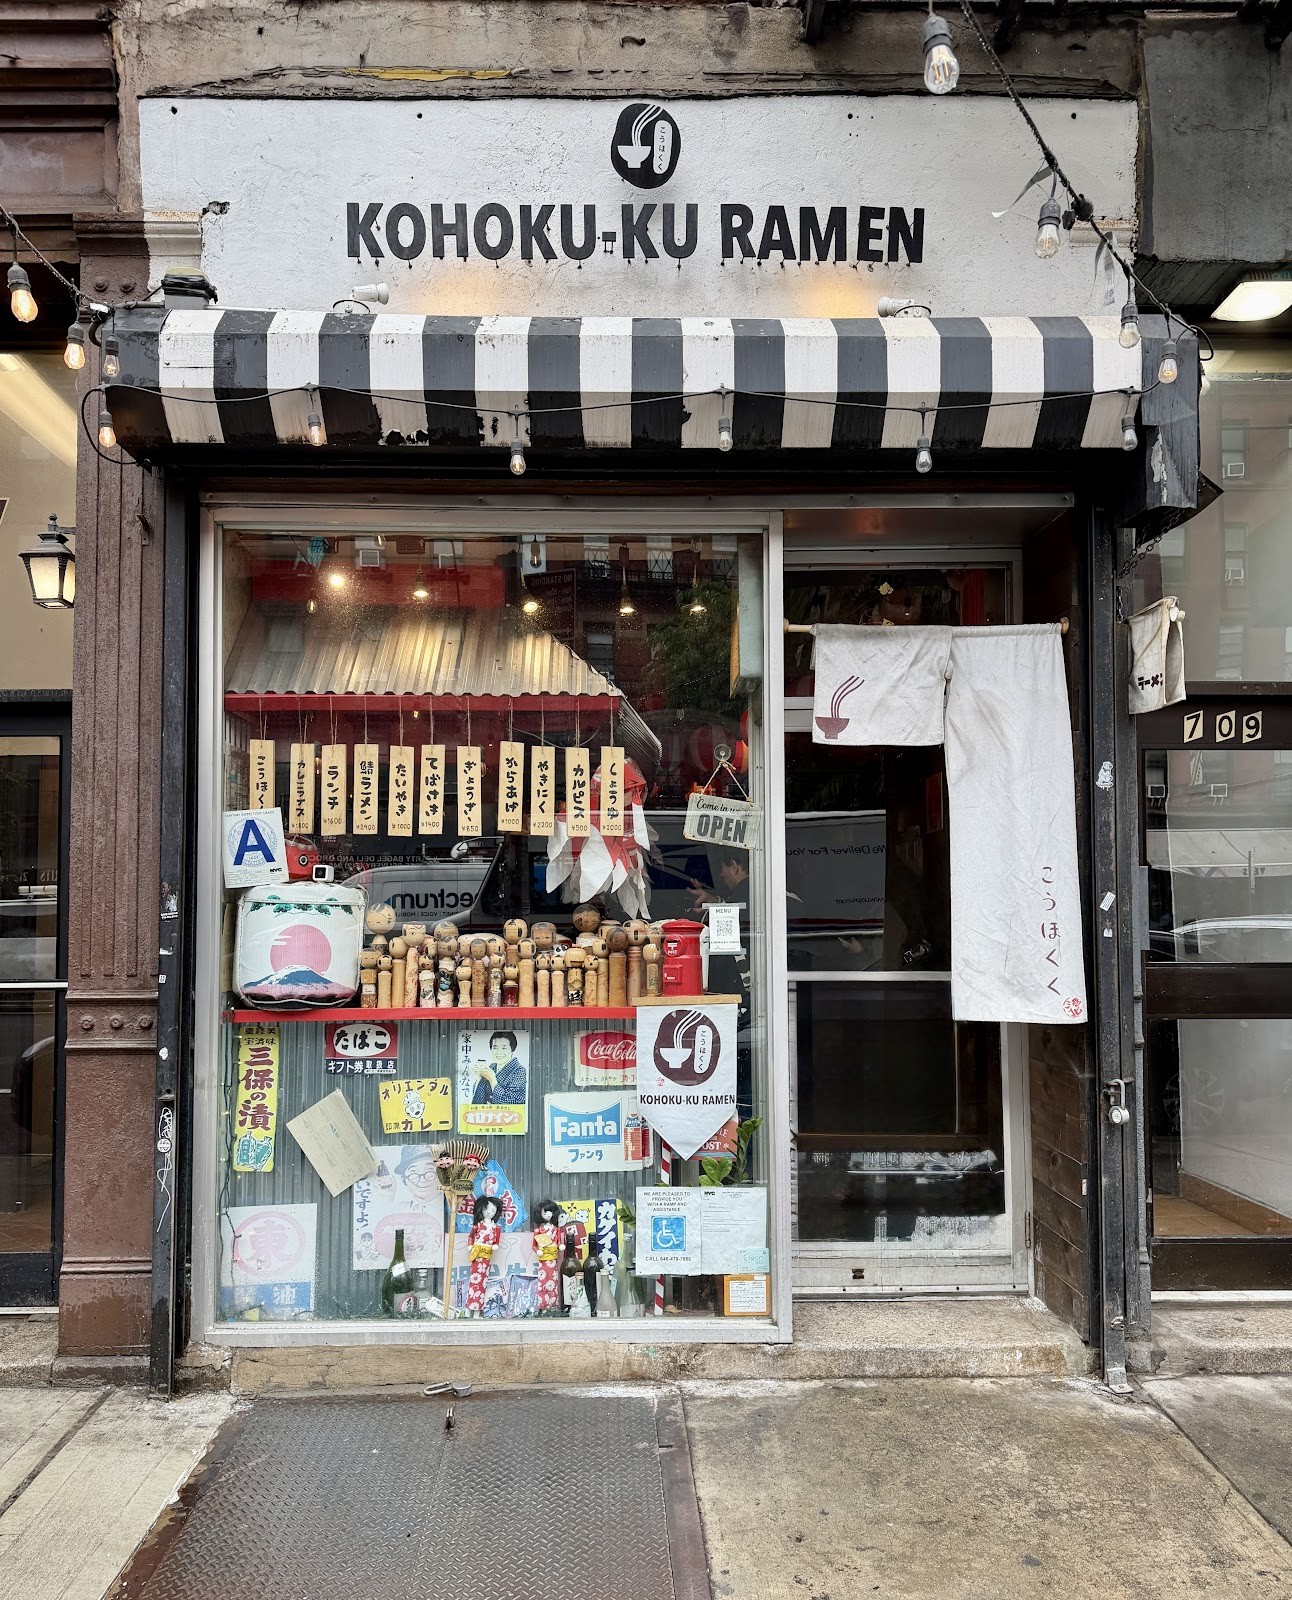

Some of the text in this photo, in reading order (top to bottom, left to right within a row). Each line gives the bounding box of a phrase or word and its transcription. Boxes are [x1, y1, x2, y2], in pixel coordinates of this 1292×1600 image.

[658, 126, 666, 171] こうほくく
[347, 203, 925, 263] KOHOKU-KU RAMEN
[1186, 712, 1260, 739] 709
[327, 765, 339, 810] ランチ
[395, 763, 408, 816] たいやき
[424, 757, 441, 817] てばさき
[463, 760, 477, 822] ぎょうざ
[505, 756, 519, 812] からあげ
[536, 760, 549, 814] やきにく
[572, 763, 586, 819] カルピス
[607, 762, 620, 820] しょうゆ
[696, 798, 720, 812] Come
[720, 804, 728, 813] in
[233, 820, 276, 866] A
[697, 814, 747, 843] OPEN
[1041, 866, 1061, 996] こうほくく
[335, 1028, 387, 1050] たばこ
[698, 1030, 707, 1071] こうほくく
[461, 1033, 472, 1098] 家中みんなで
[640, 1094, 736, 1106] KOHOKU-KU RAMEN
[401, 1118, 450, 1131] カレー
[554, 1116, 617, 1142] Fanta
[702, 1141, 721, 1151] OST
[568, 1148, 603, 1163] ファンタ
[597, 1201, 618, 1279] カクイわ
